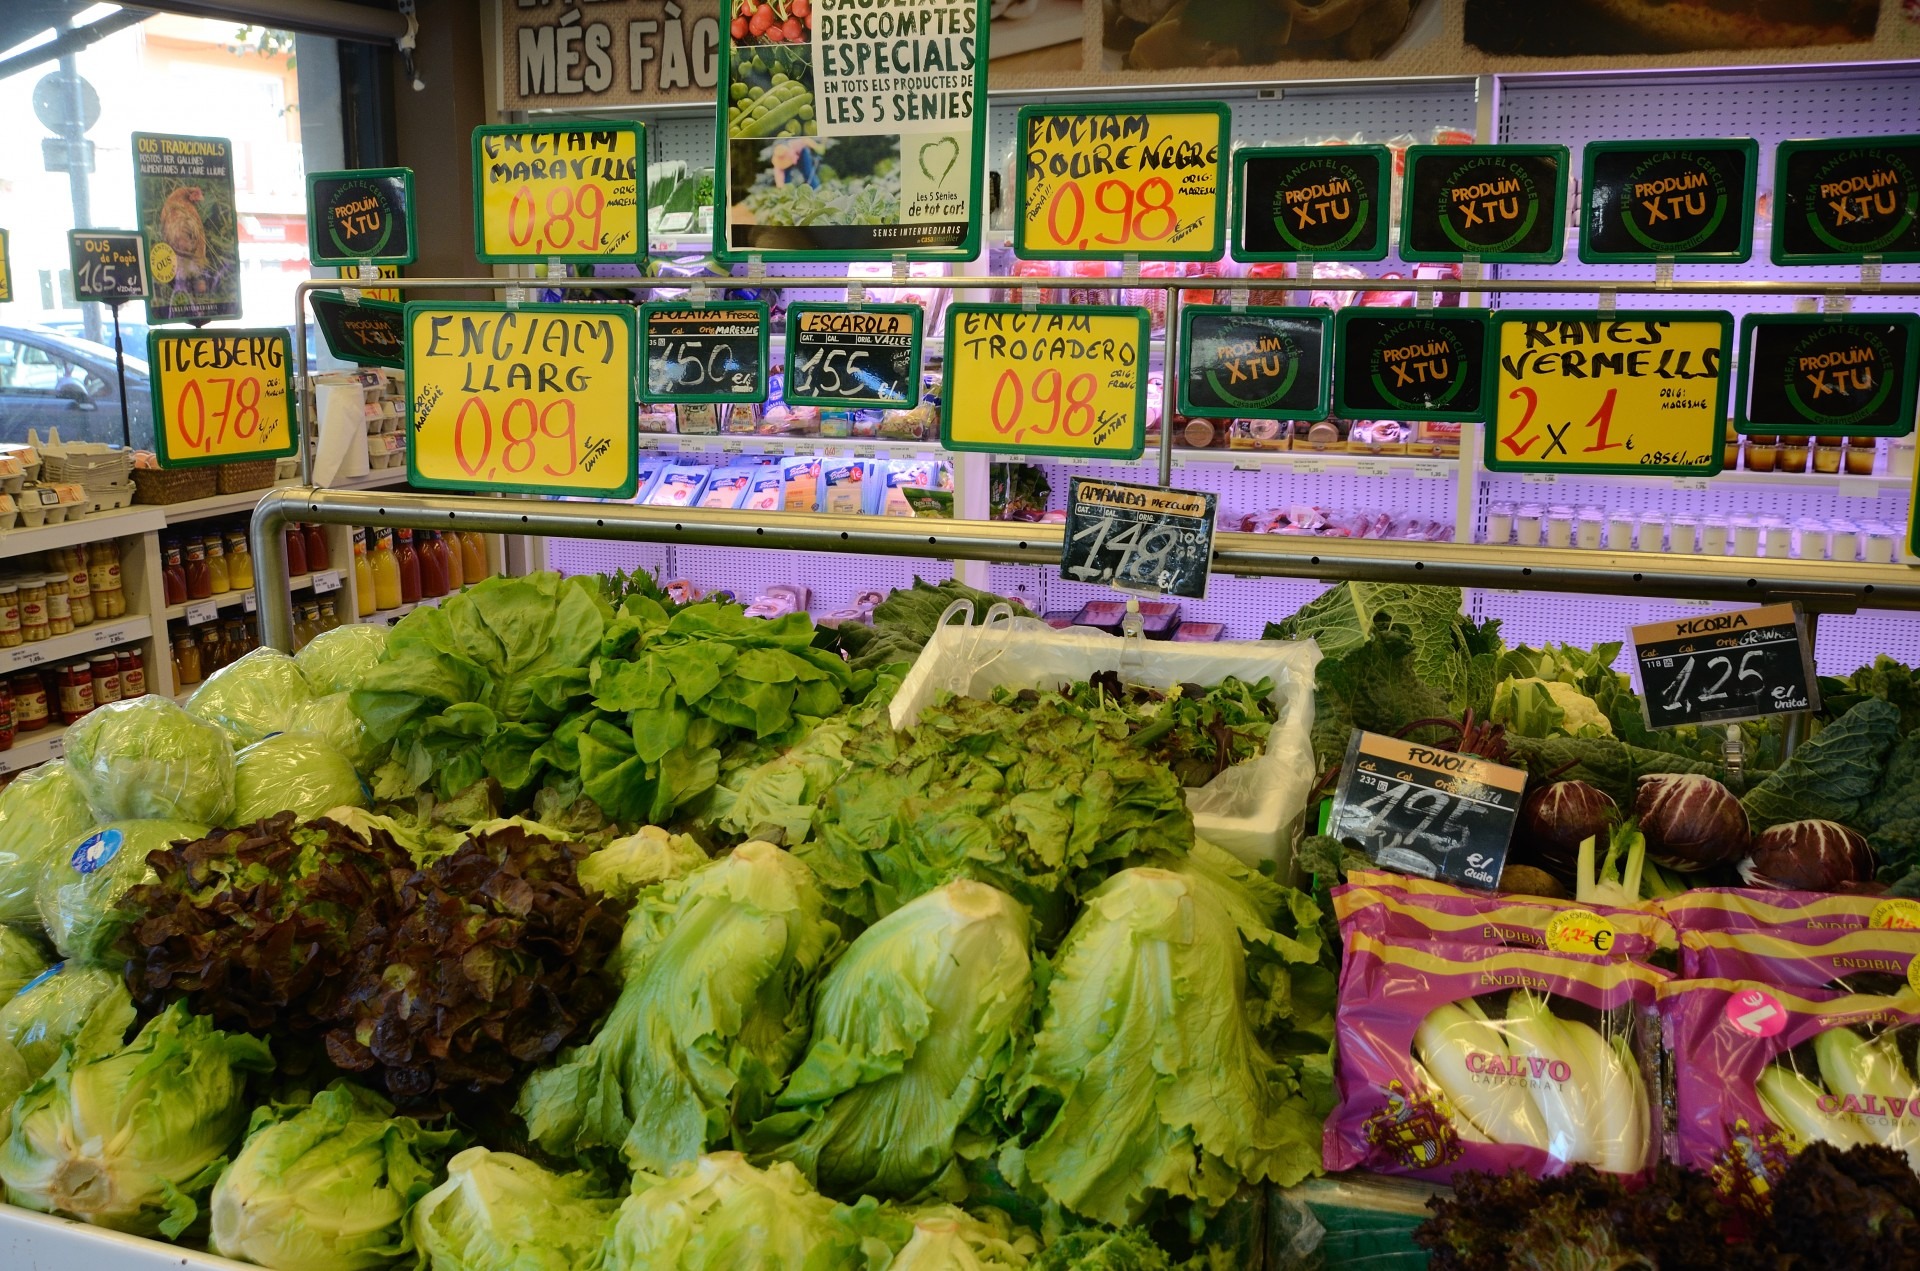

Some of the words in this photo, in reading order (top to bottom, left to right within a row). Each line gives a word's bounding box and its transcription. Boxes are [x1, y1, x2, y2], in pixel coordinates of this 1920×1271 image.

[821, 8, 976, 41] DESCOMPTES
[518, 8, 613, 96] MÉS
[822, 37, 975, 77] ESPECIALS
[824, 81, 838, 94] EN
[842, 79, 868, 93] TOTS
[872, 78, 890, 91] ELS
[893, 75, 958, 91] PRODUCTES
[961, 74, 973, 87] DE
[825, 95, 865, 124] LES
[872, 95, 885, 123] 5
[892, 90, 973, 122] SÈNIES
[1028, 113, 1150, 149] ENCIAM
[138, 137, 158, 152] OUS
[160, 139, 225, 157] TRADICIONALS
[163, 155, 175, 164] PER
[177, 156, 204, 165] GALLINES
[1027, 143, 1137, 182] ROURE
[916, 192, 928, 201] Les
[929, 192, 934, 201] 5
[1285, 177, 1351, 205] PRODUÏM
[1452, 177, 1520, 203] PRODUÏM
[1634, 171, 1708, 198] PRODUÏM
[1820, 169, 1898, 199] PRODUÏM
[335, 195, 379, 219] PRODUÏM
[508, 183, 605, 255] 0,89
[908, 201, 922, 217] de
[924, 202, 941, 216] tot
[943, 200, 965, 216] cor!
[1048, 176, 1178, 251] 0,98
[872, 228, 898, 237] SENSE
[899, 225, 961, 236] INTERMEDIARIS
[85, 239, 110, 253] OUS
[100, 253, 111, 264] de
[113, 250, 137, 268] Pagès
[156, 256, 173, 272] OUS
[808, 314, 899, 333] ESCAROLA
[1522, 320, 1671, 349] RAVES
[426, 311, 614, 365] ENCIAM
[964, 334, 1136, 366] TROCADERO
[1383, 339, 1450, 363] PRODUÏM
[164, 336, 283, 372] ICEBERG
[1501, 347, 1721, 381] VERMELLS
[1799, 345, 1875, 371] PRODUÏM
[461, 362, 592, 393] LLARG
[177, 376, 261, 453] 0,78
[991, 368, 1098, 444] 0,98
[1500, 386, 1540, 457] 2
[1583, 388, 1622, 452] 1
[454, 396, 578, 481] 0,89
[1080, 485, 1147, 507] AMANIDA
[1077, 505, 1091, 514] CAT.
[1138, 513, 1155, 522] ORIG.
[1179, 532, 1206, 545] 100
[1676, 614, 1748, 636] XICORIA
[1678, 644, 1696, 654] Cal.
[1646, 660, 1661, 669] 118
[1662, 650, 1766, 714] 1,25
[1359, 775, 1377, 786] 232
[1396, 771, 1414, 783] Cal.
[1483, 926, 1544, 946] ENDIBIA
[1833, 957, 1902, 971] ENDIBIA
[1480, 974, 1548, 988] ENDIBIA
[1465, 1052, 1571, 1083] CALVO
[1471, 1074, 1551, 1092] CATEGORIA
